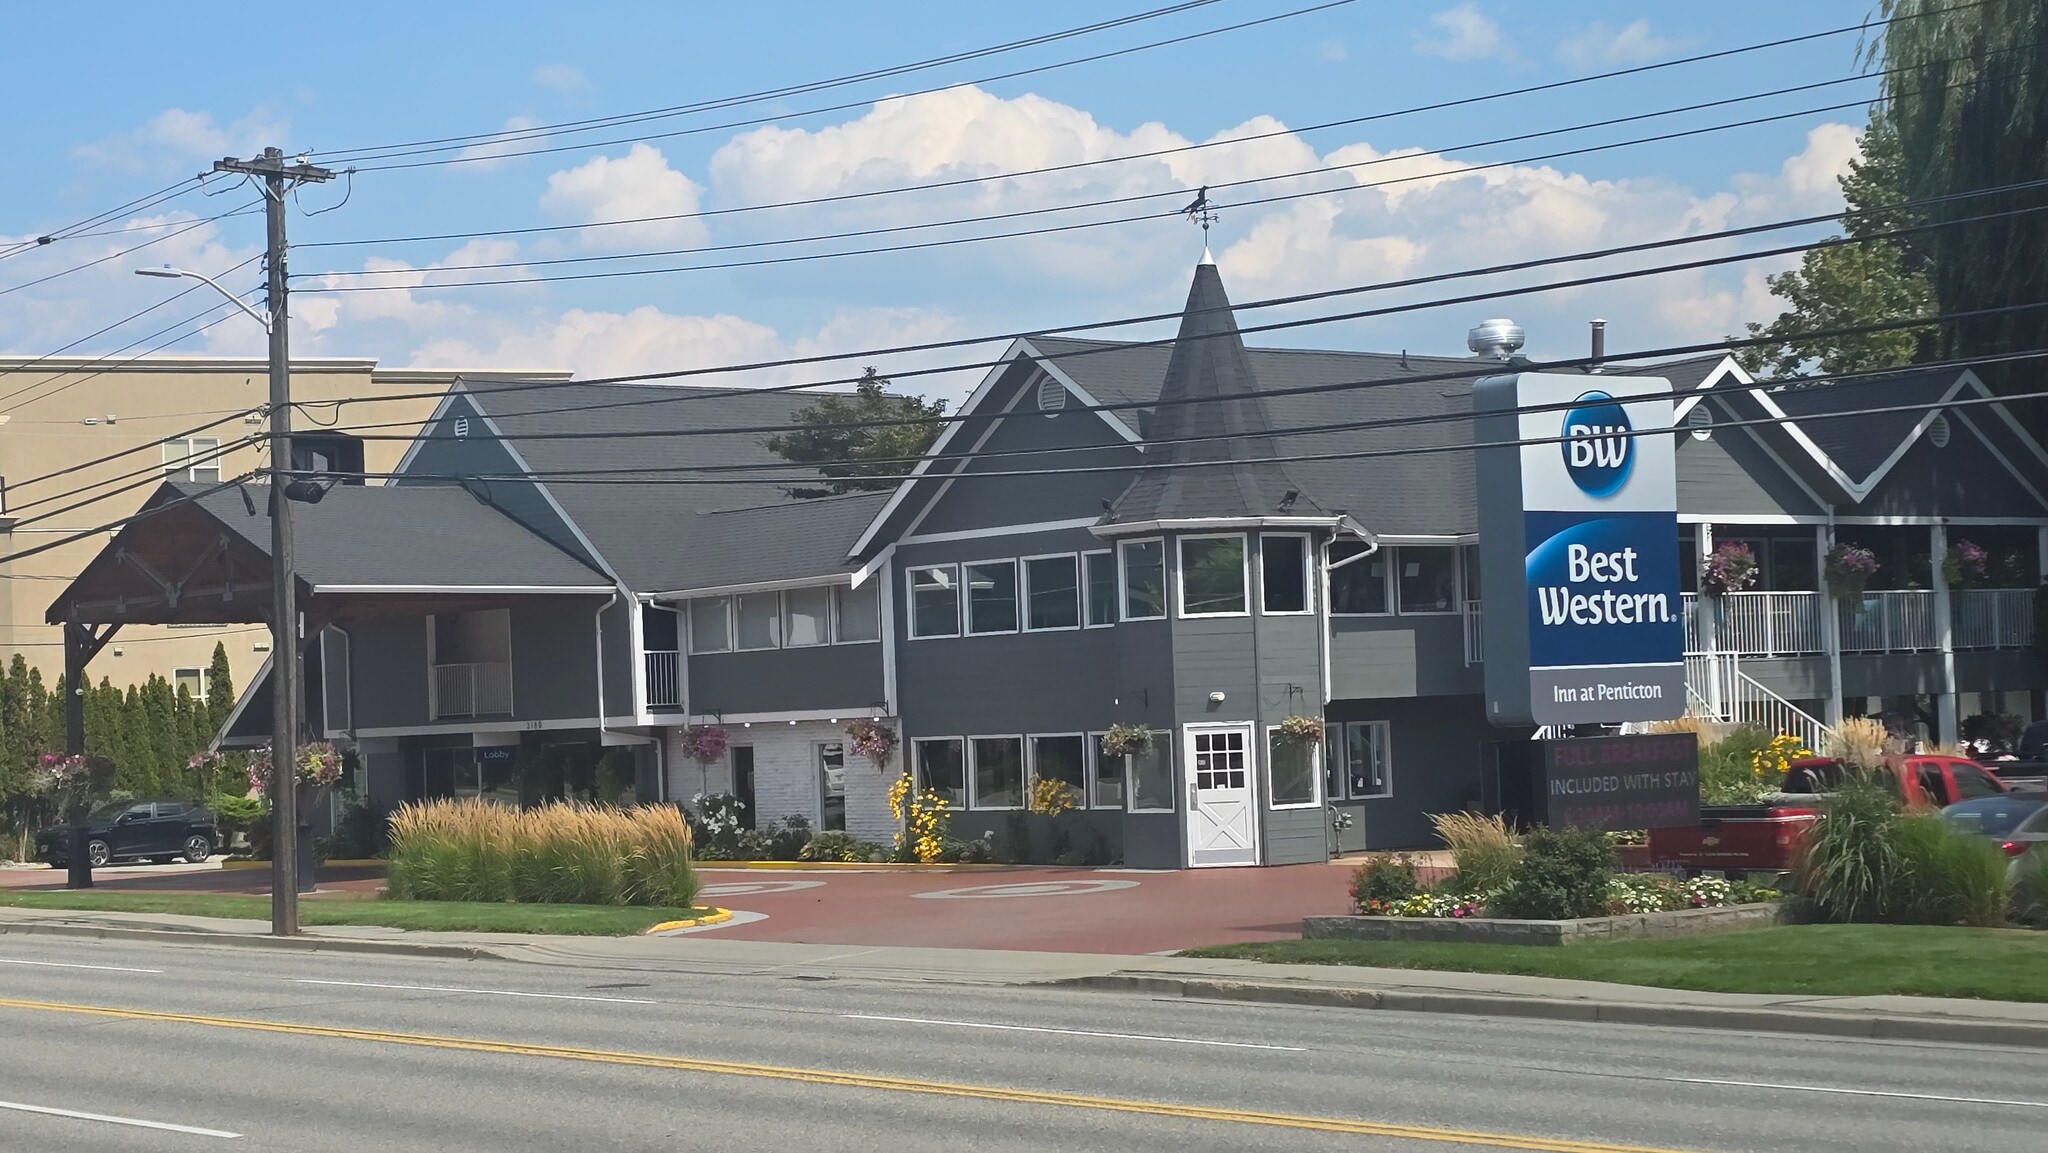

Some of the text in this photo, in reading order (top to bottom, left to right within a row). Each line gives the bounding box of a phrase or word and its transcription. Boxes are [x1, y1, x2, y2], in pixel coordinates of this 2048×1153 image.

[1569, 424, 1627, 468] BW
[1568, 543, 1639, 583] Best
[1553, 681, 1662, 703] Inn at Penticton
[484, 750, 509, 759] Lobby
[1553, 739, 1692, 767] FULL BREAKFAST
[1550, 771, 1697, 796] INCLUDED WITH STAY
